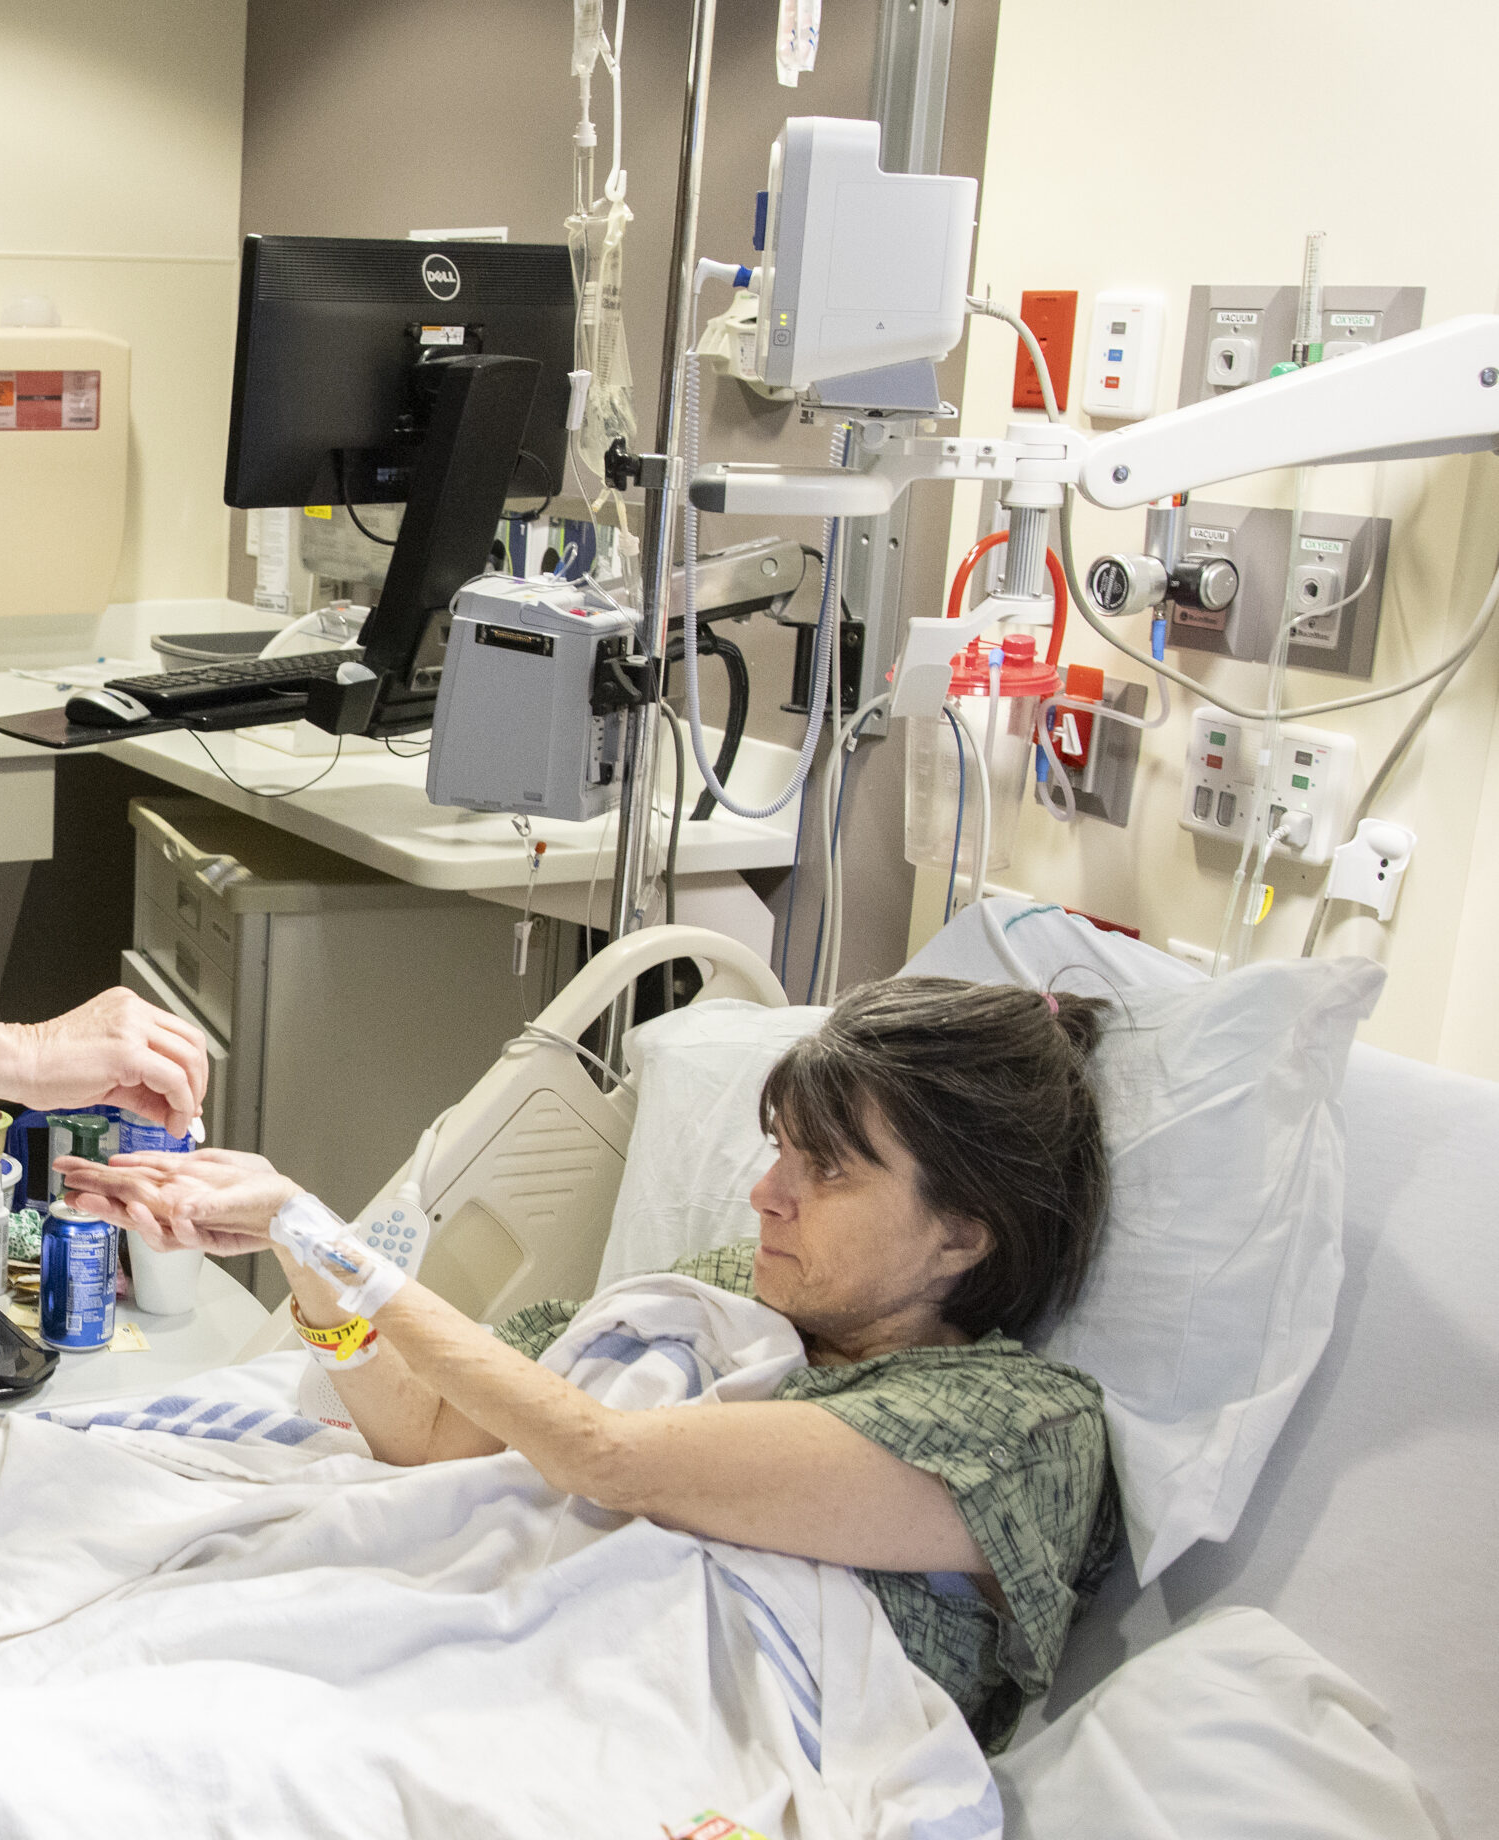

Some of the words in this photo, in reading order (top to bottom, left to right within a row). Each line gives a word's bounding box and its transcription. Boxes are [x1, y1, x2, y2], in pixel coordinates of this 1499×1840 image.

[427, 270, 456, 283] DELL
[1220, 313, 1254, 323] VACUUM
[1334, 315, 1371, 325] OXYGEN
[1193, 528, 1226, 541] VACUUM
[1304, 539, 1340, 552] OXYGEN
